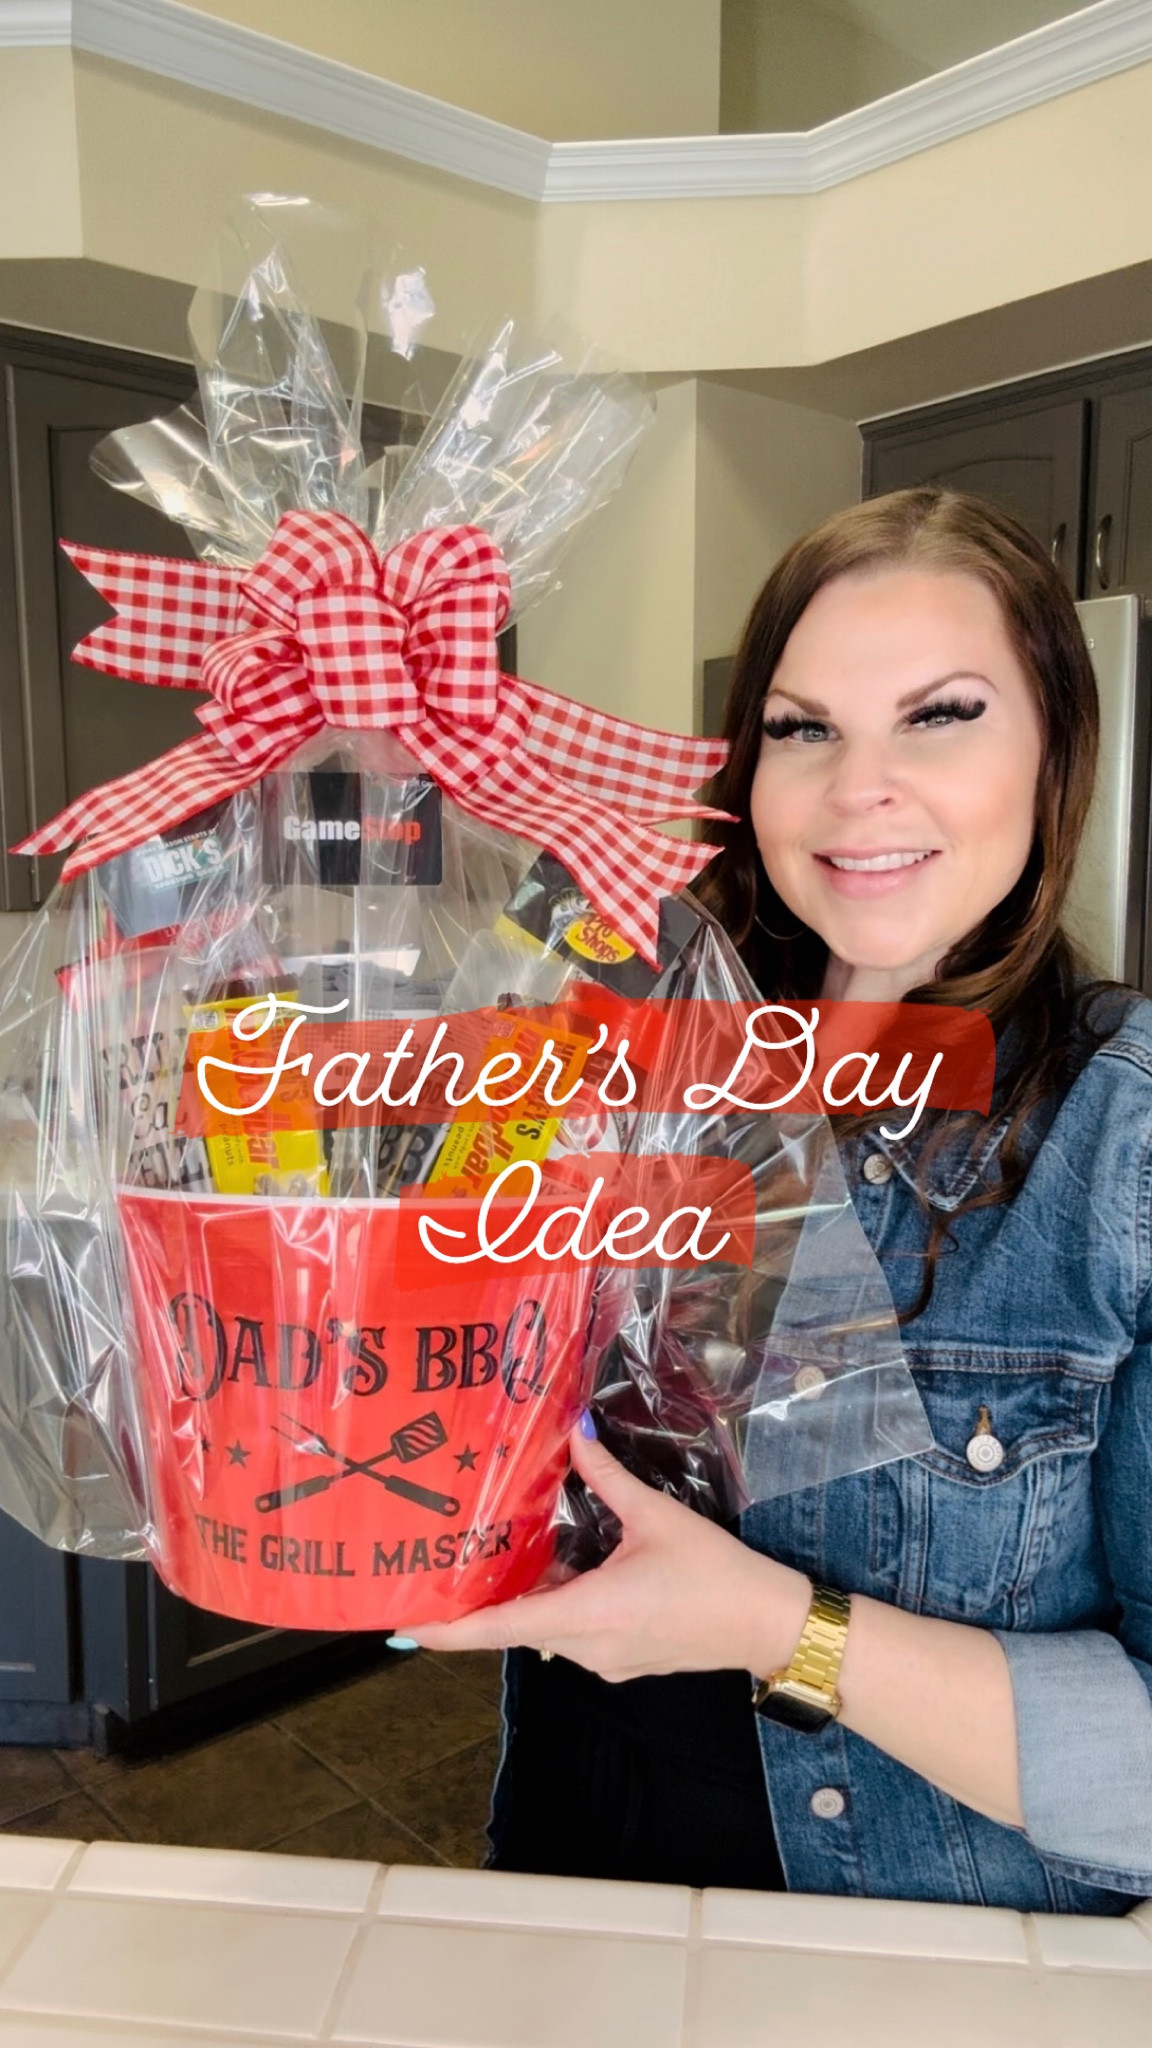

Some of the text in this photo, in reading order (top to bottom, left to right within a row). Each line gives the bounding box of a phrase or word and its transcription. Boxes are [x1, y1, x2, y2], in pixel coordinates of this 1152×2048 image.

[283, 815, 421, 845] GameStop
[143, 839, 221, 883] DICK'S
[575, 926, 620, 962] Shops
[443, 1126, 465, 1167] peanuts
[170, 1292, 549, 1403] DAD'S BBQ
[198, 1514, 512, 1578] THE GRILL MASTER
